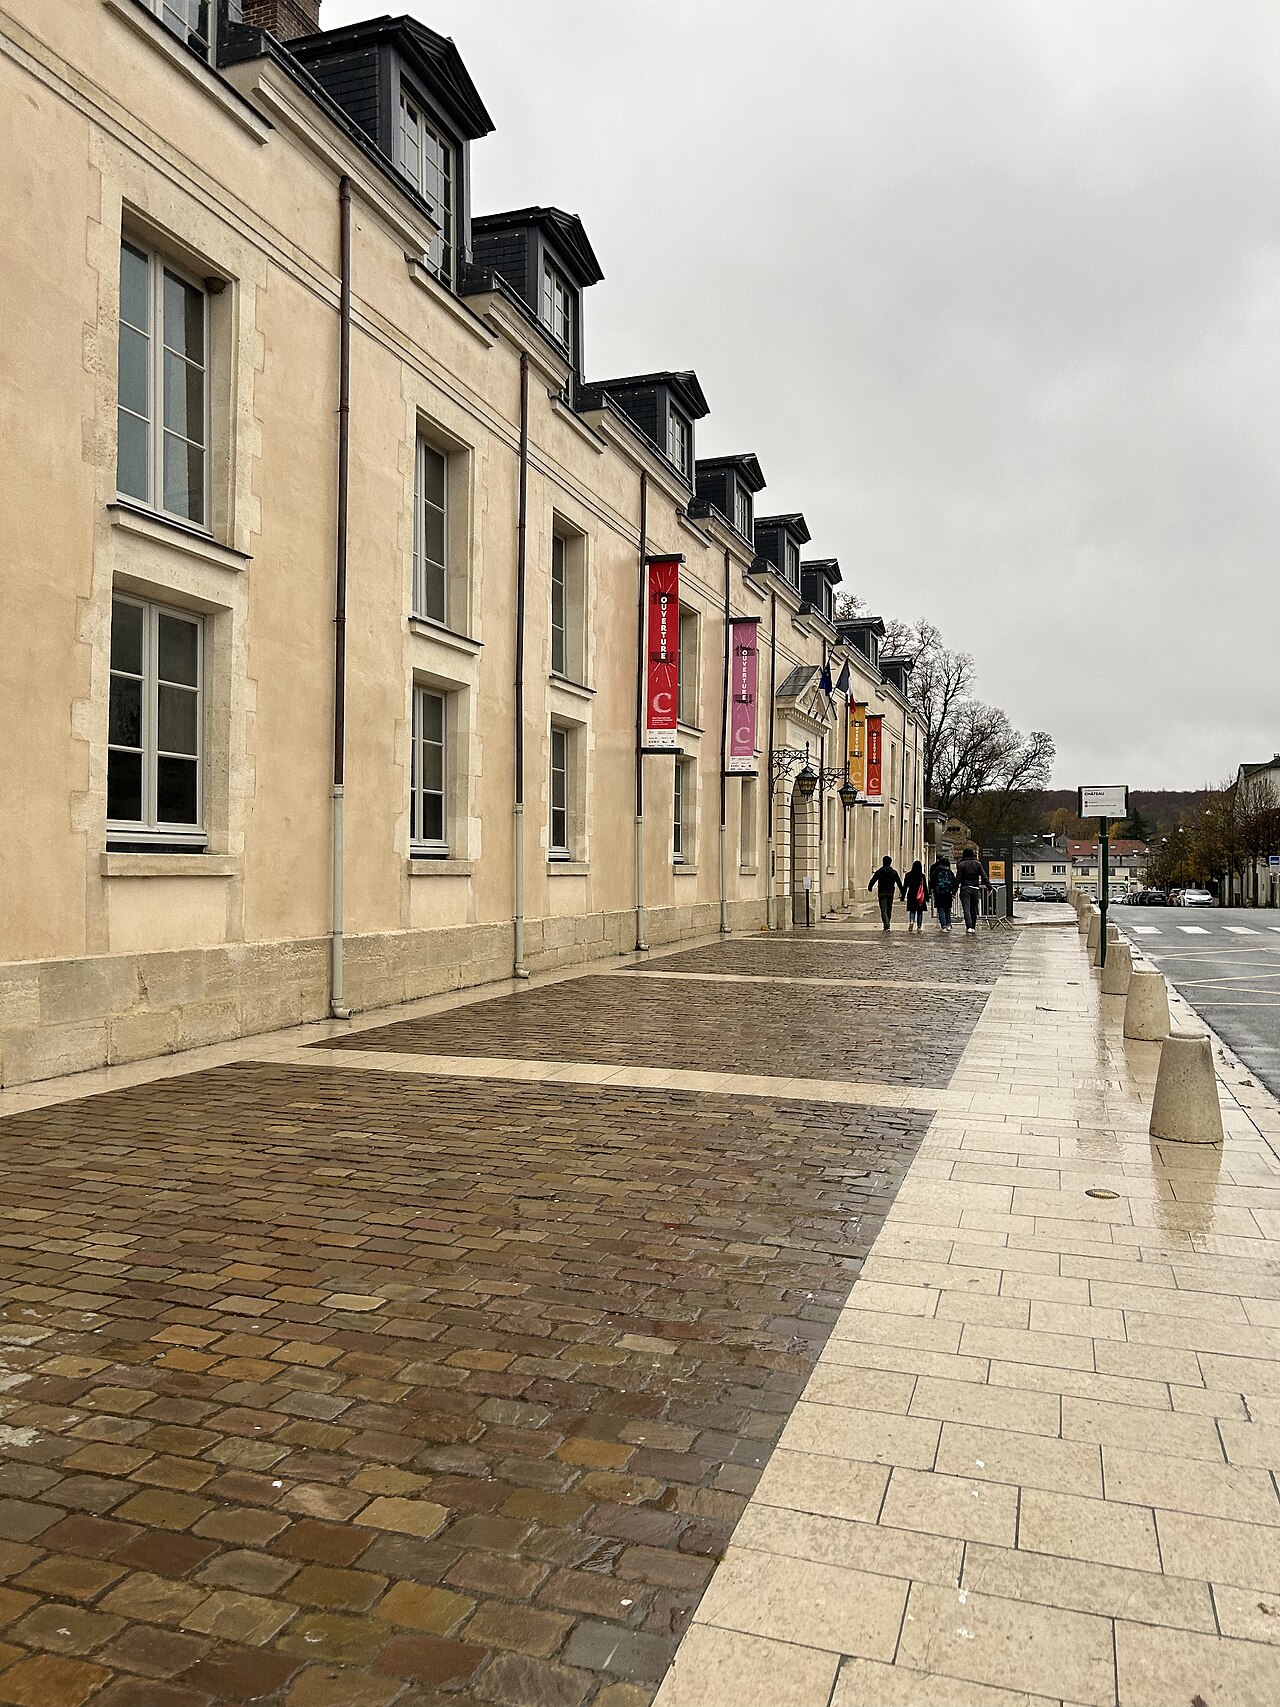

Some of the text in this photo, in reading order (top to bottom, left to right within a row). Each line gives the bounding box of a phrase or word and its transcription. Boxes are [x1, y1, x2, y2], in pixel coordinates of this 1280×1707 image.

[660, 596, 668, 660] OUVERTURE
[652, 692, 671, 713] C
[735, 726, 750, 743] C
[869, 777, 879, 788] C
